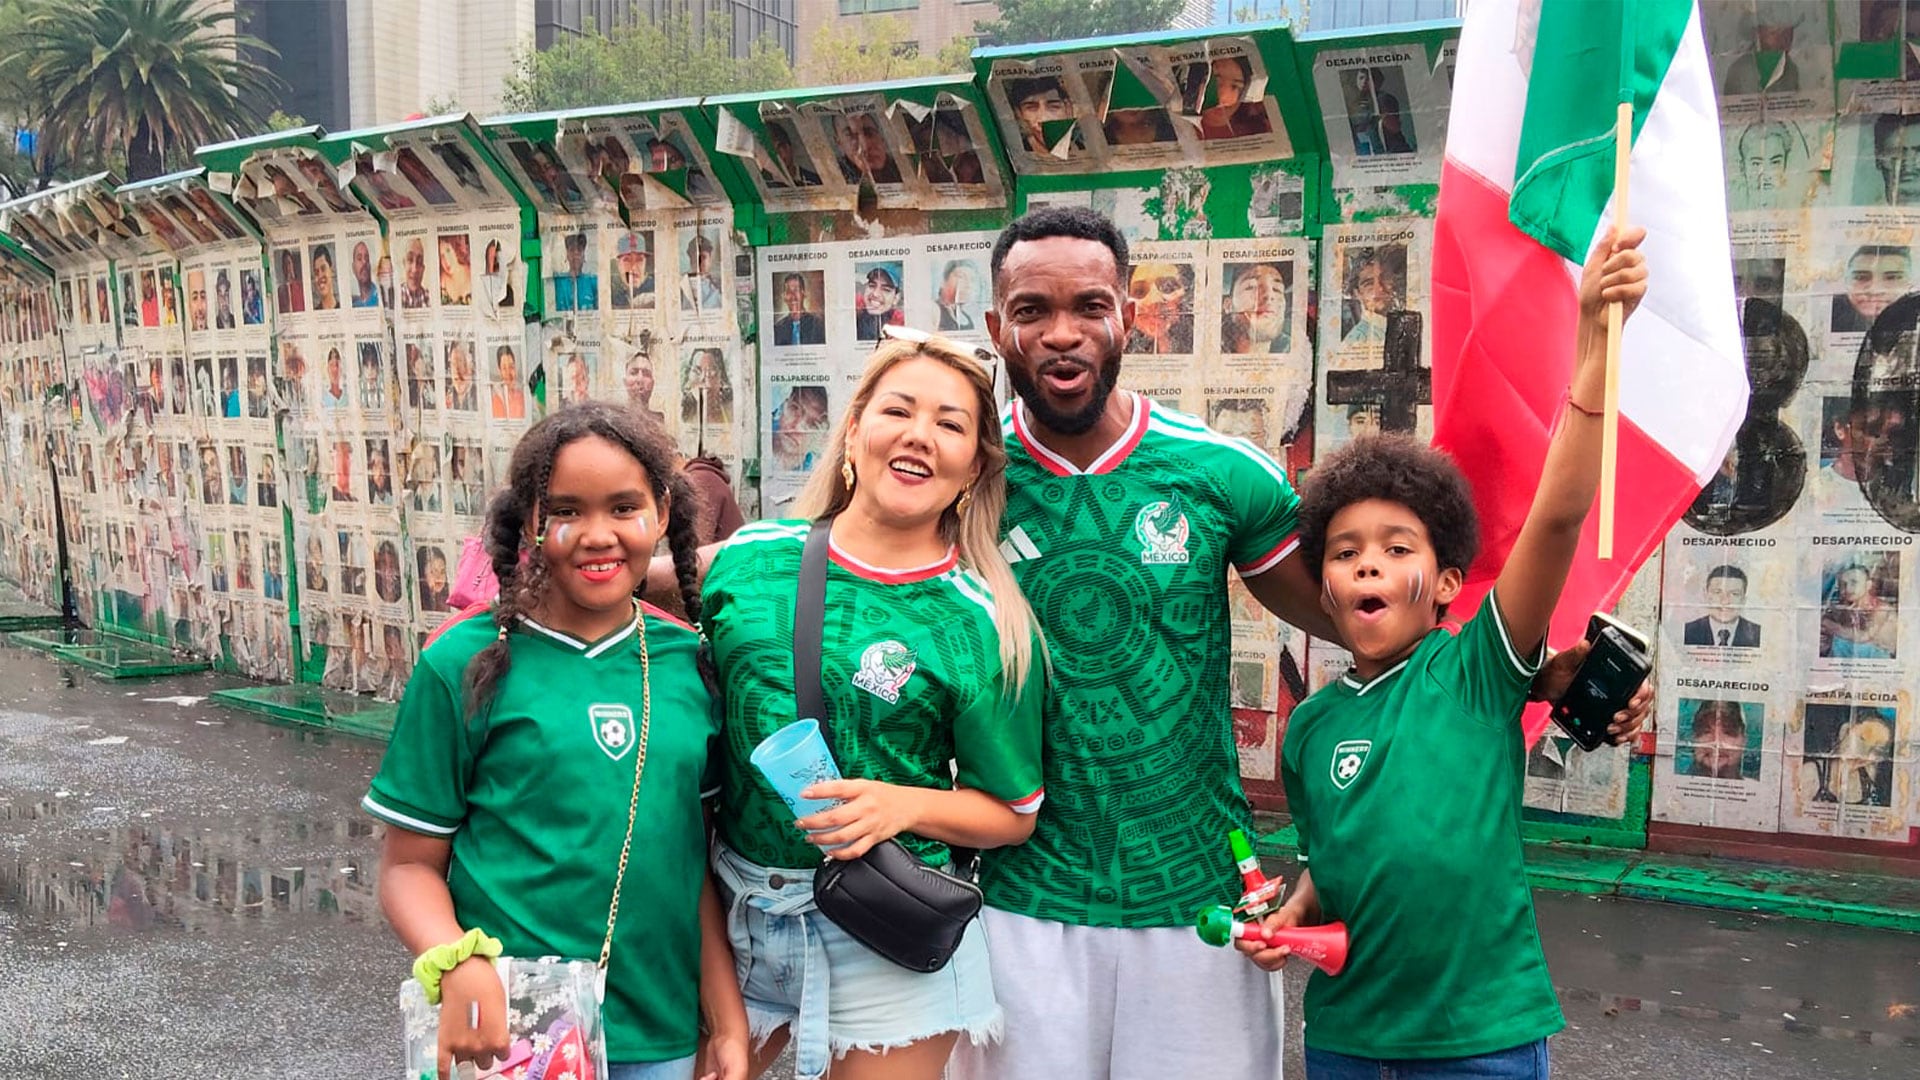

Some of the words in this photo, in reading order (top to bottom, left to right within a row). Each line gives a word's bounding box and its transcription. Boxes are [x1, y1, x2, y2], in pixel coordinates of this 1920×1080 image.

[1337, 229, 1415, 245] DESAPARECIDO
[926, 240, 993, 253] DESAPARECIDO
[767, 251, 828, 263] DESAPARECIDO
[848, 247, 911, 259] DESAPARECIDO
[1222, 248, 1295, 259] DESAPARECIDO
[770, 374, 831, 383] DESAPARECIDO
[1203, 386, 1275, 396] DESAPARECIDO
[1682, 537, 1777, 548] DESAPARECIDO
[1812, 535, 1913, 546] DESAPARECIDO
[1676, 678, 1770, 692] DESAPARECIDO
